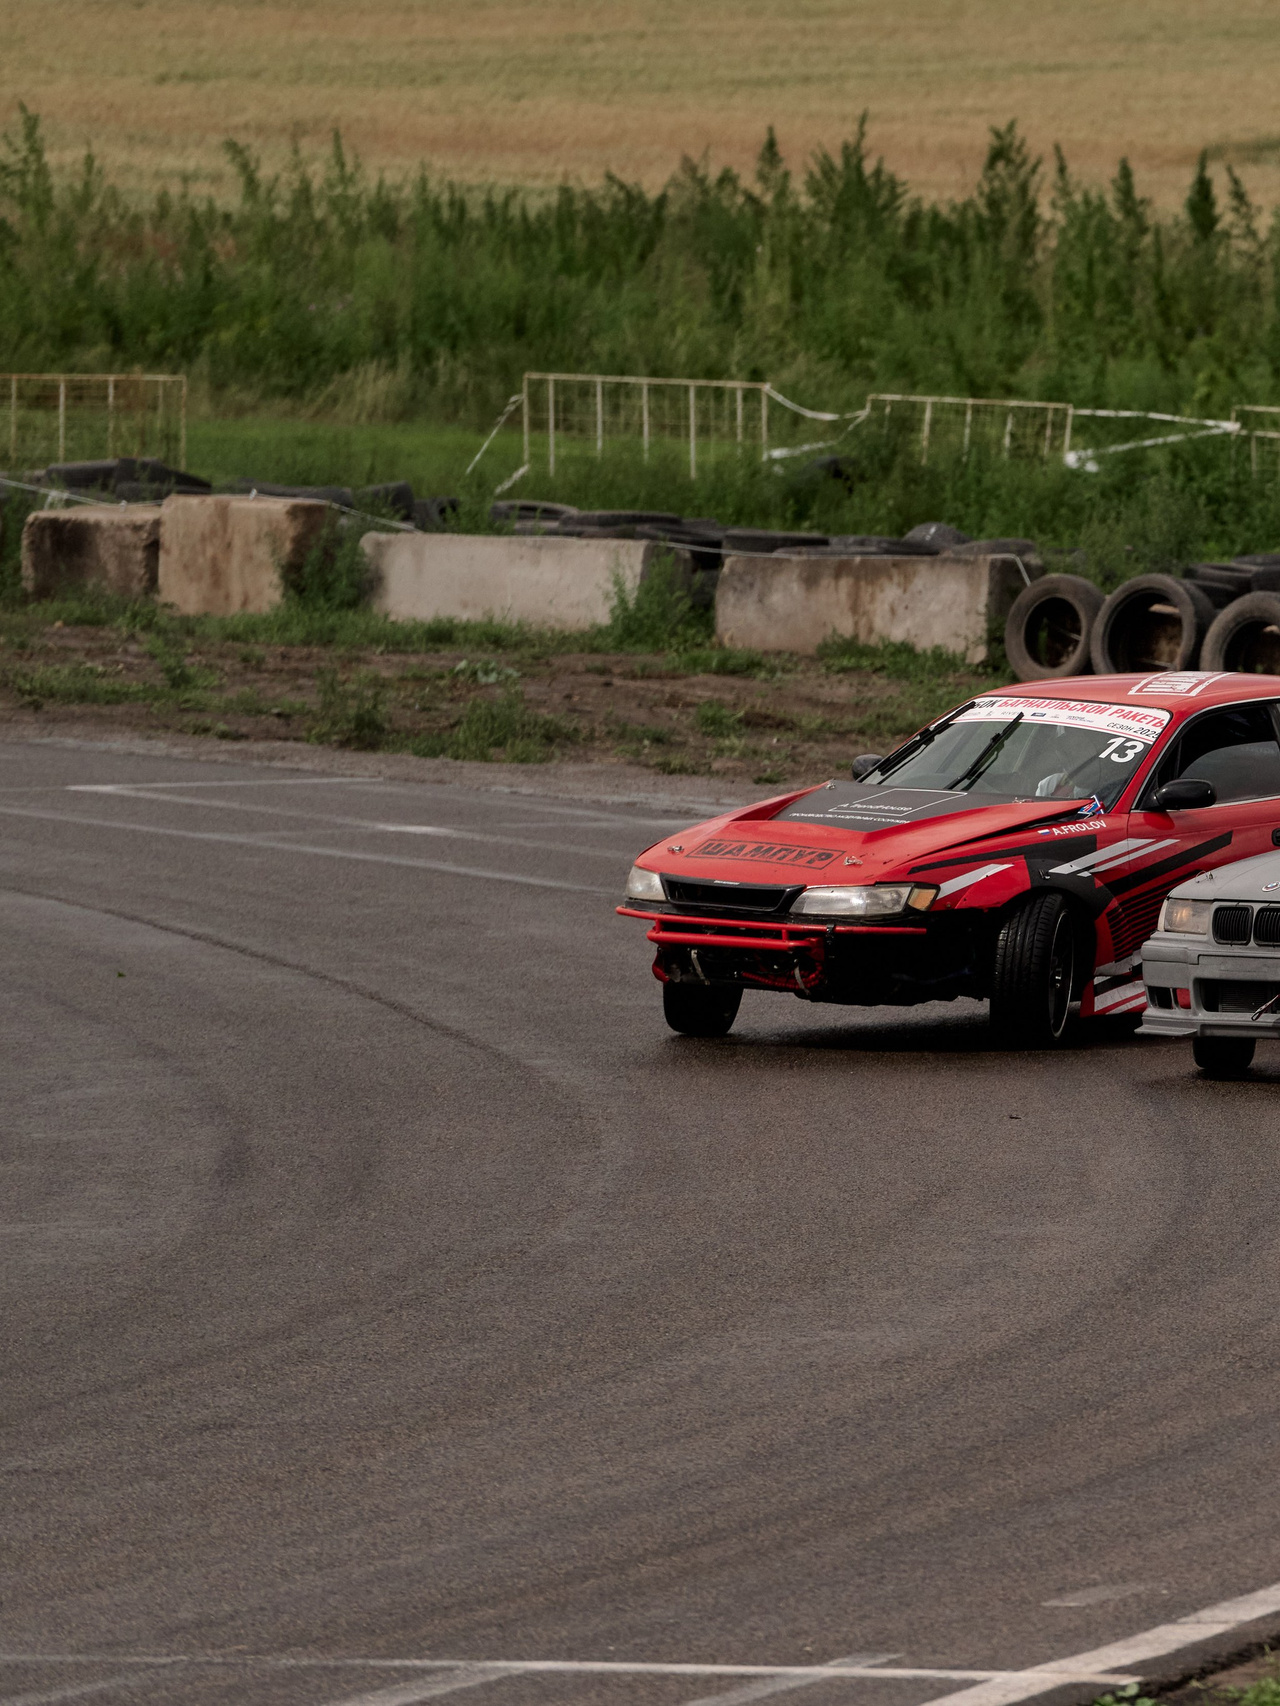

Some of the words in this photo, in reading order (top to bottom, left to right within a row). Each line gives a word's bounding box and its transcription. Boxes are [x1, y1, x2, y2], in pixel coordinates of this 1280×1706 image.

[998, 698, 1112, 715] БАРНАУЛЬСКОЙ
[1107, 722, 1134, 732] СЕЗОН
[1098, 737, 1144, 763] 13
[1052, 819, 1106, 837] A.FROLOV
[699, 842, 834, 865] ШАМПУР
